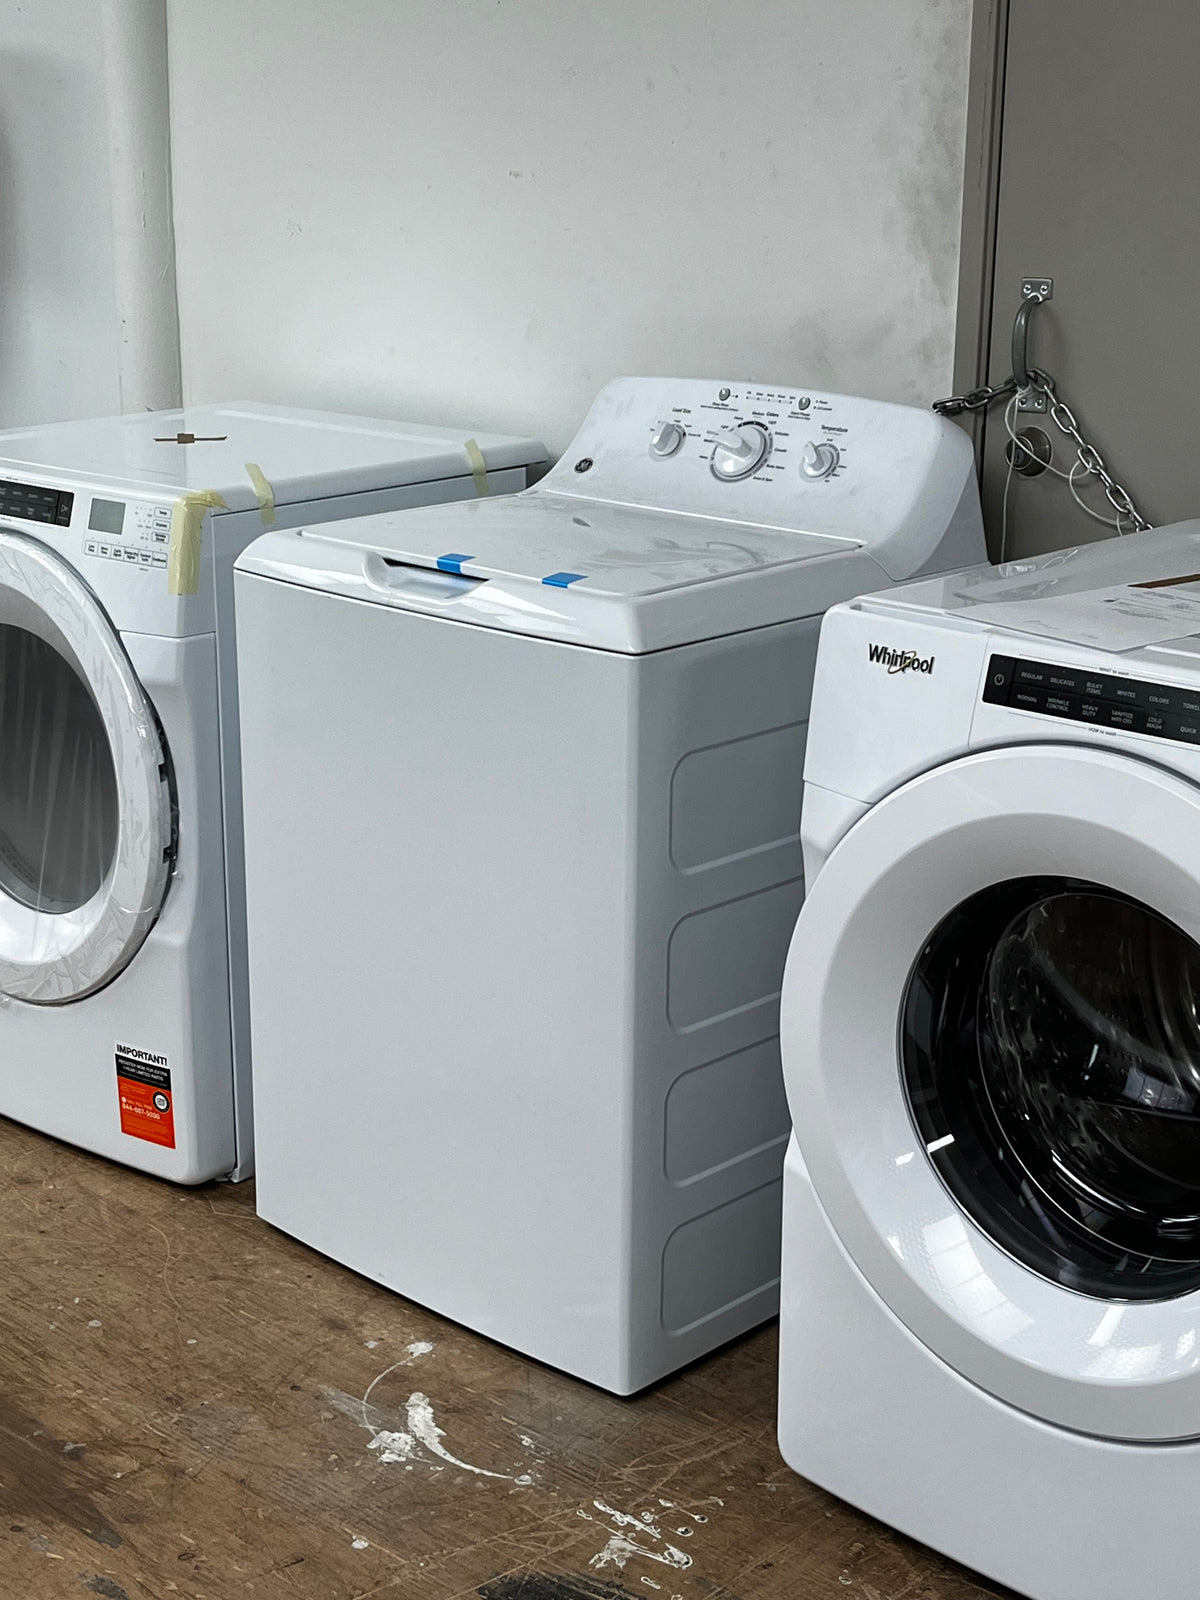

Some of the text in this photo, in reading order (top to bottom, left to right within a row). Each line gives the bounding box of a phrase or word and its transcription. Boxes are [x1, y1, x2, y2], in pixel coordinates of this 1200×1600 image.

[868, 643, 935, 675] Whirlpool
[1148, 695, 1170, 705] COLORS
[1179, 726, 1198, 735] QUICK
[116, 1043, 168, 1066] IMPORTANT!
